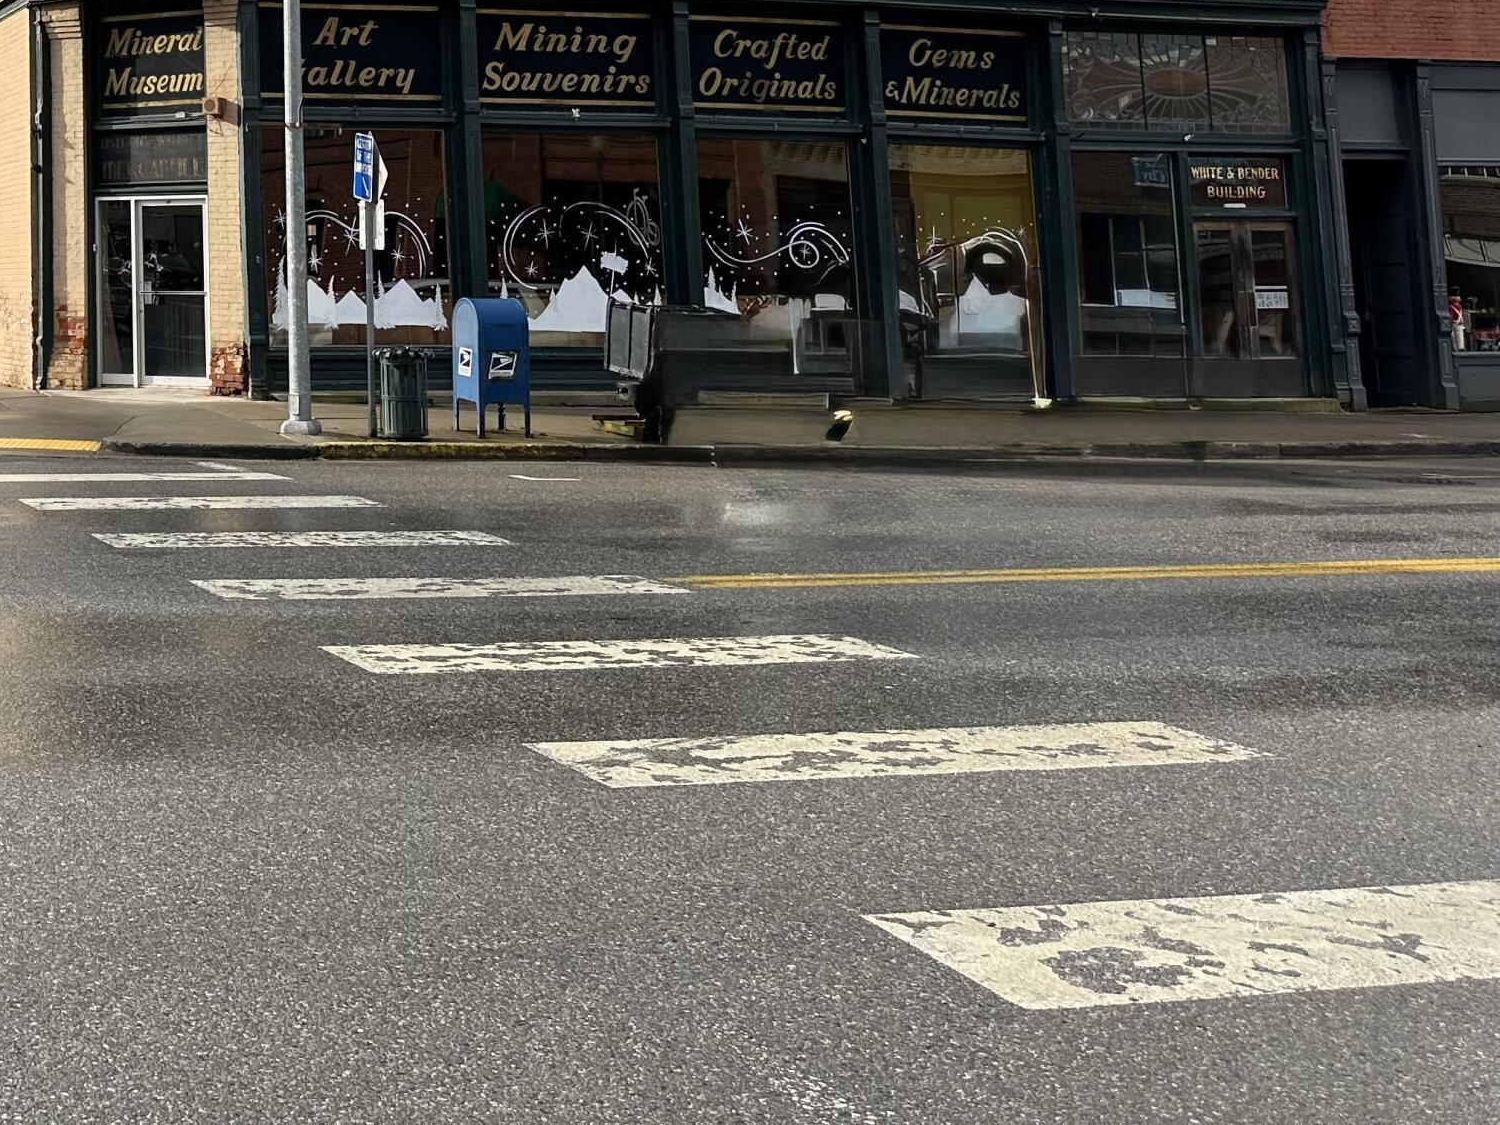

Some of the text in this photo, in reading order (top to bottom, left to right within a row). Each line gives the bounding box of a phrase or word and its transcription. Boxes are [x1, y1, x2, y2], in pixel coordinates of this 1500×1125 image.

[104, 26, 203, 58] Mineral
[312, 16, 380, 46] Art
[493, 22, 637, 63] Mining
[713, 29, 831, 69] Crafted
[908, 38, 996, 69] Gems
[104, 67, 204, 96] Museum
[301, 58, 415, 93] allery
[482, 61, 651, 94] Souvenirs
[699, 66, 837, 103] Originals
[1190, 166, 1279, 180] WHITE & BENDER
[1207, 185, 1266, 199] BUILDING
